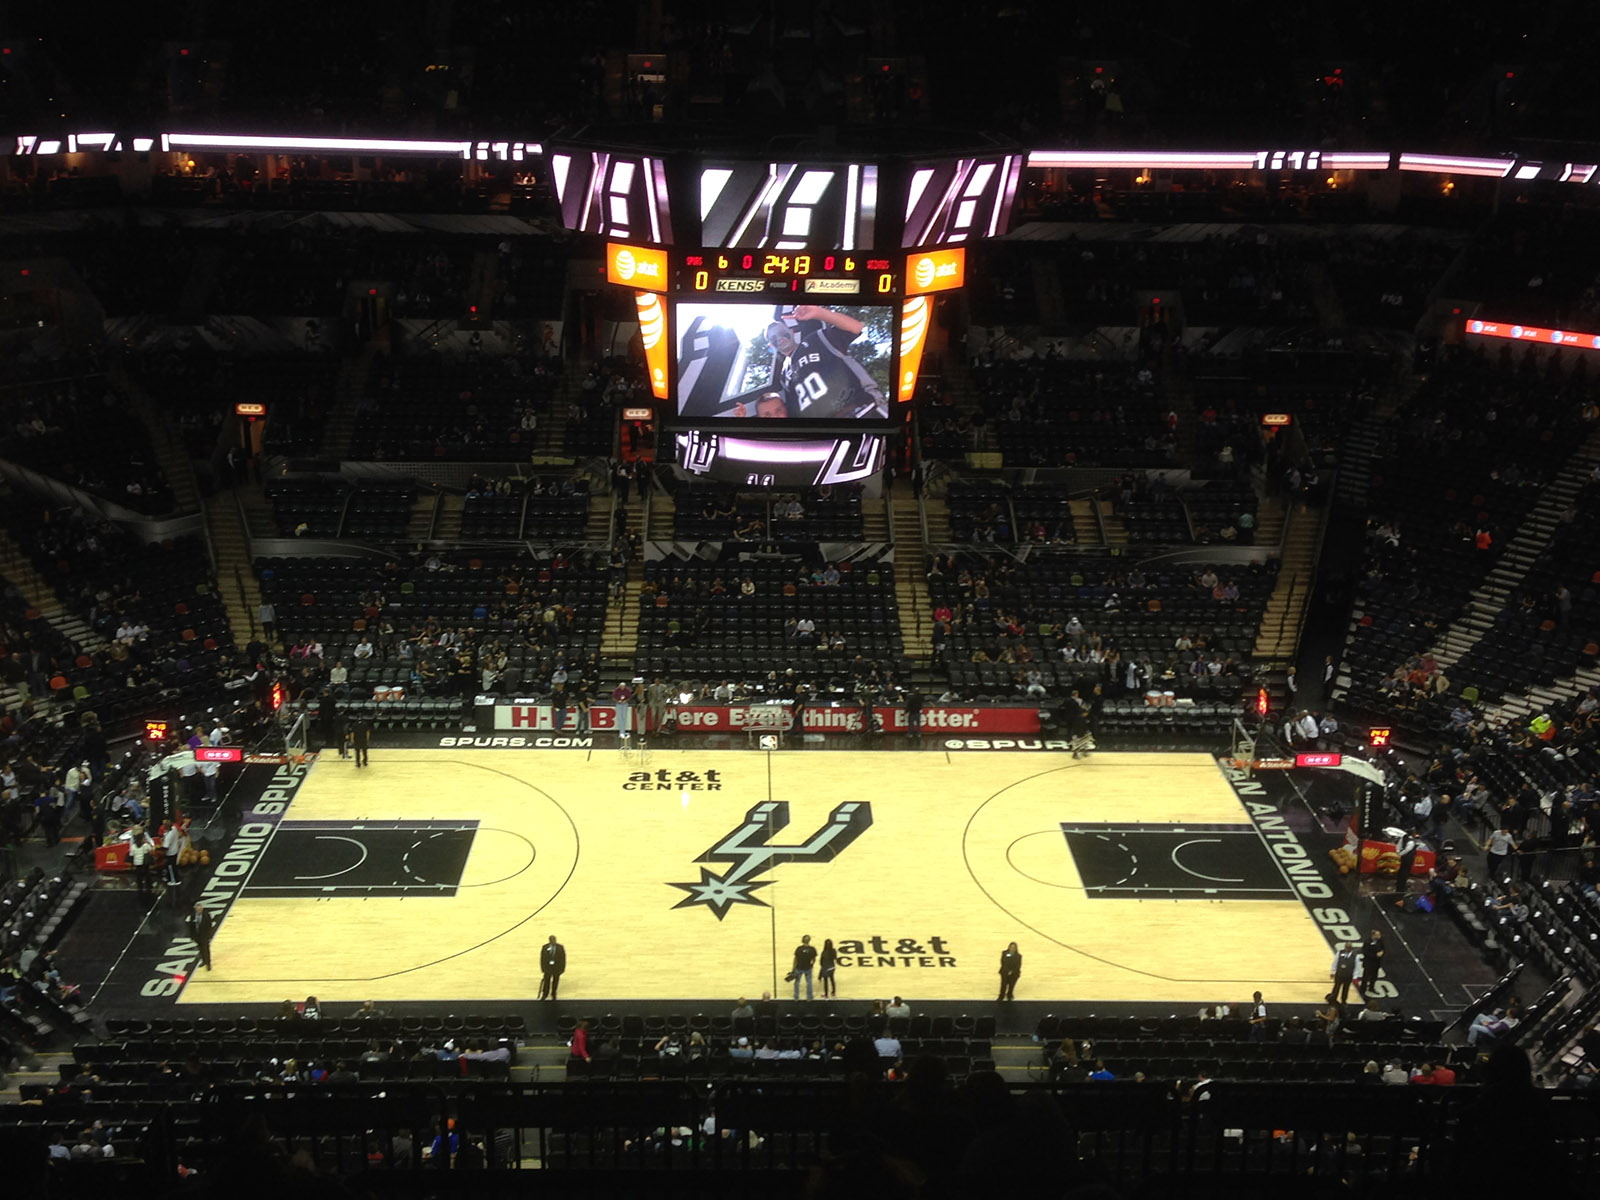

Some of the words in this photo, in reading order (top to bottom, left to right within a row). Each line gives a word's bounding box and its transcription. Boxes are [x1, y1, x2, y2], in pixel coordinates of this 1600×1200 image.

[742, 255, 753, 270] 0
[763, 255, 810, 275] 24:13
[824, 256, 834, 271] 0
[695, 271, 709, 290] 0
[791, 279, 798, 292] 1
[819, 280, 859, 291] Academy
[878, 274, 892, 293] 0
[794, 371, 828, 411] 20
[439, 737, 594, 748] SPURS.COM
[628, 768, 722, 783] at&t
[622, 783, 722, 792] CENTER
[1246, 801, 1334, 899] ANTONIO
[837, 935, 950, 955] at&t
[140, 937, 201, 997] SAN
[836, 956, 957, 968] CENTER
